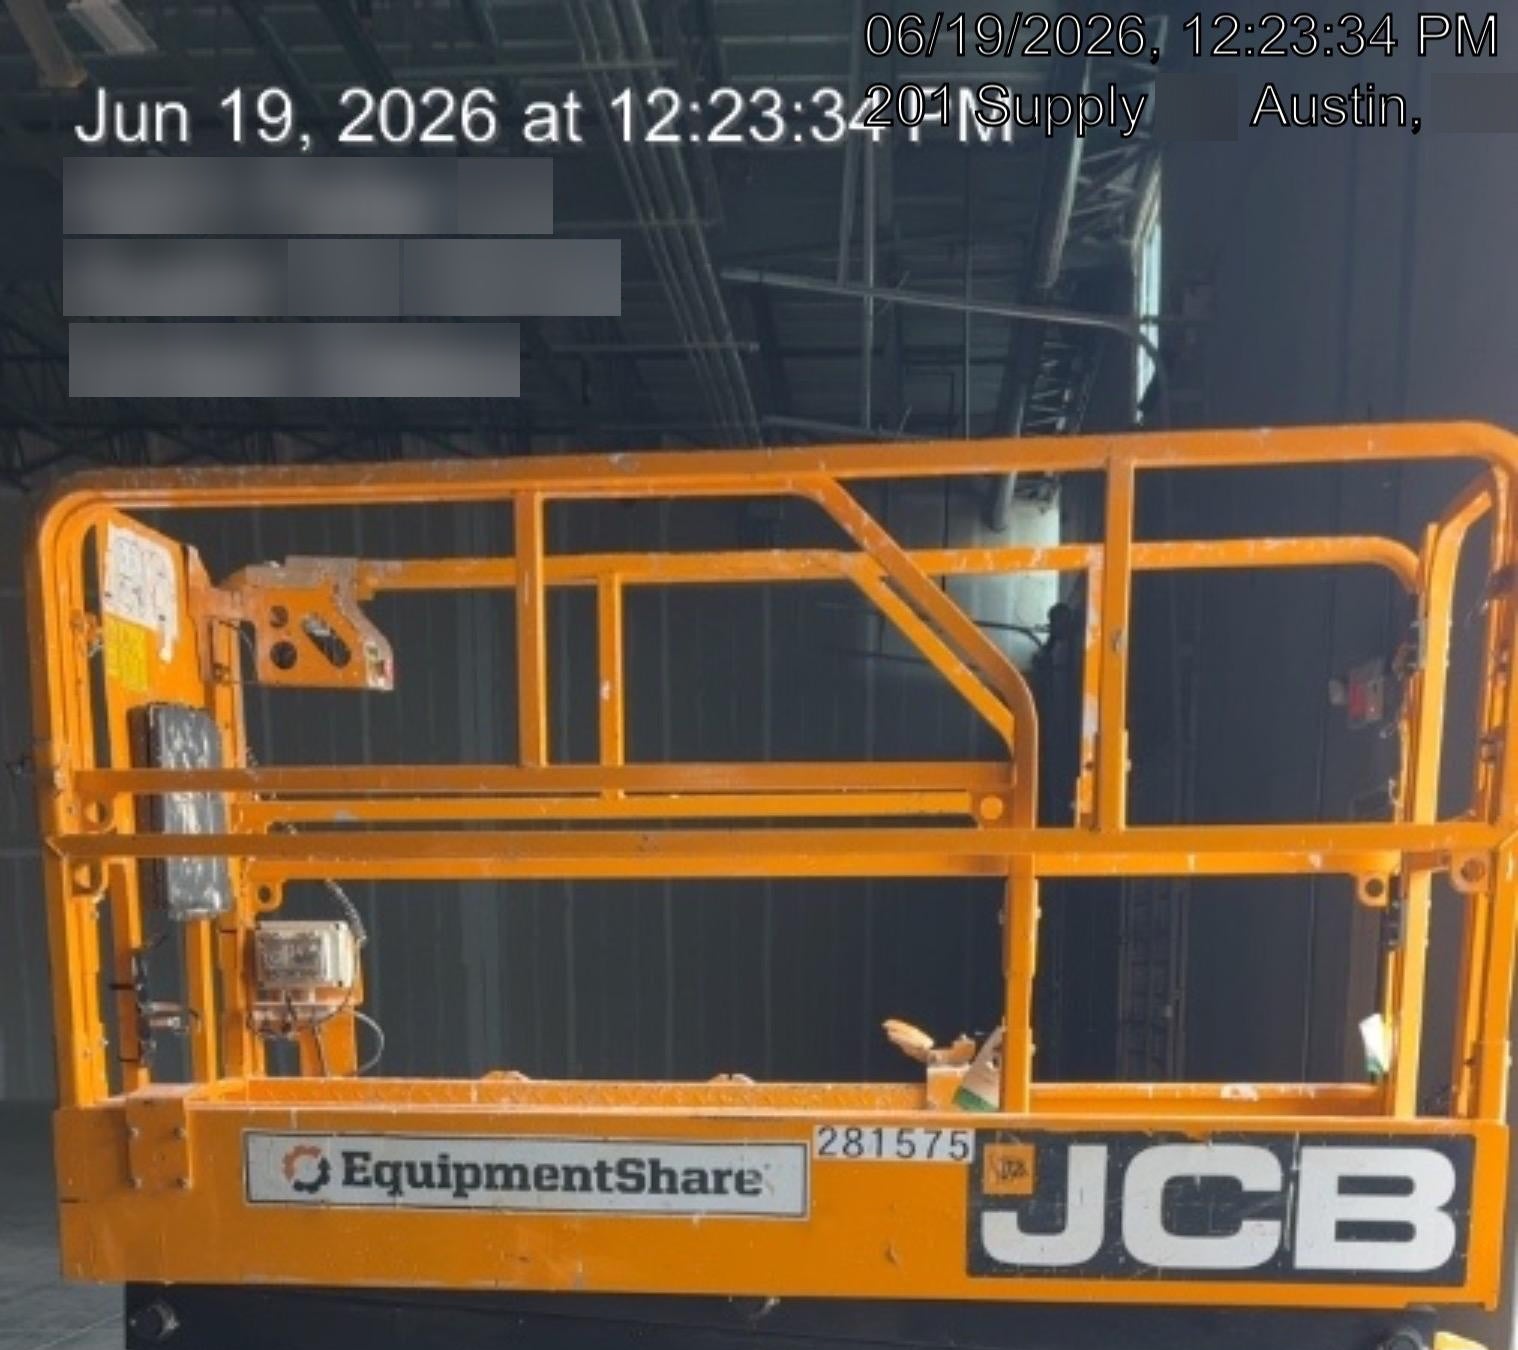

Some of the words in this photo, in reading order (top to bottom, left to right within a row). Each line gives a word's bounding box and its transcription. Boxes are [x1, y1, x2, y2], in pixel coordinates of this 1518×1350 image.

[816, 1126, 971, 1160] 281575
[341, 1151, 764, 1199] EquipmentShare
[983, 1144, 1456, 1270] JCB
